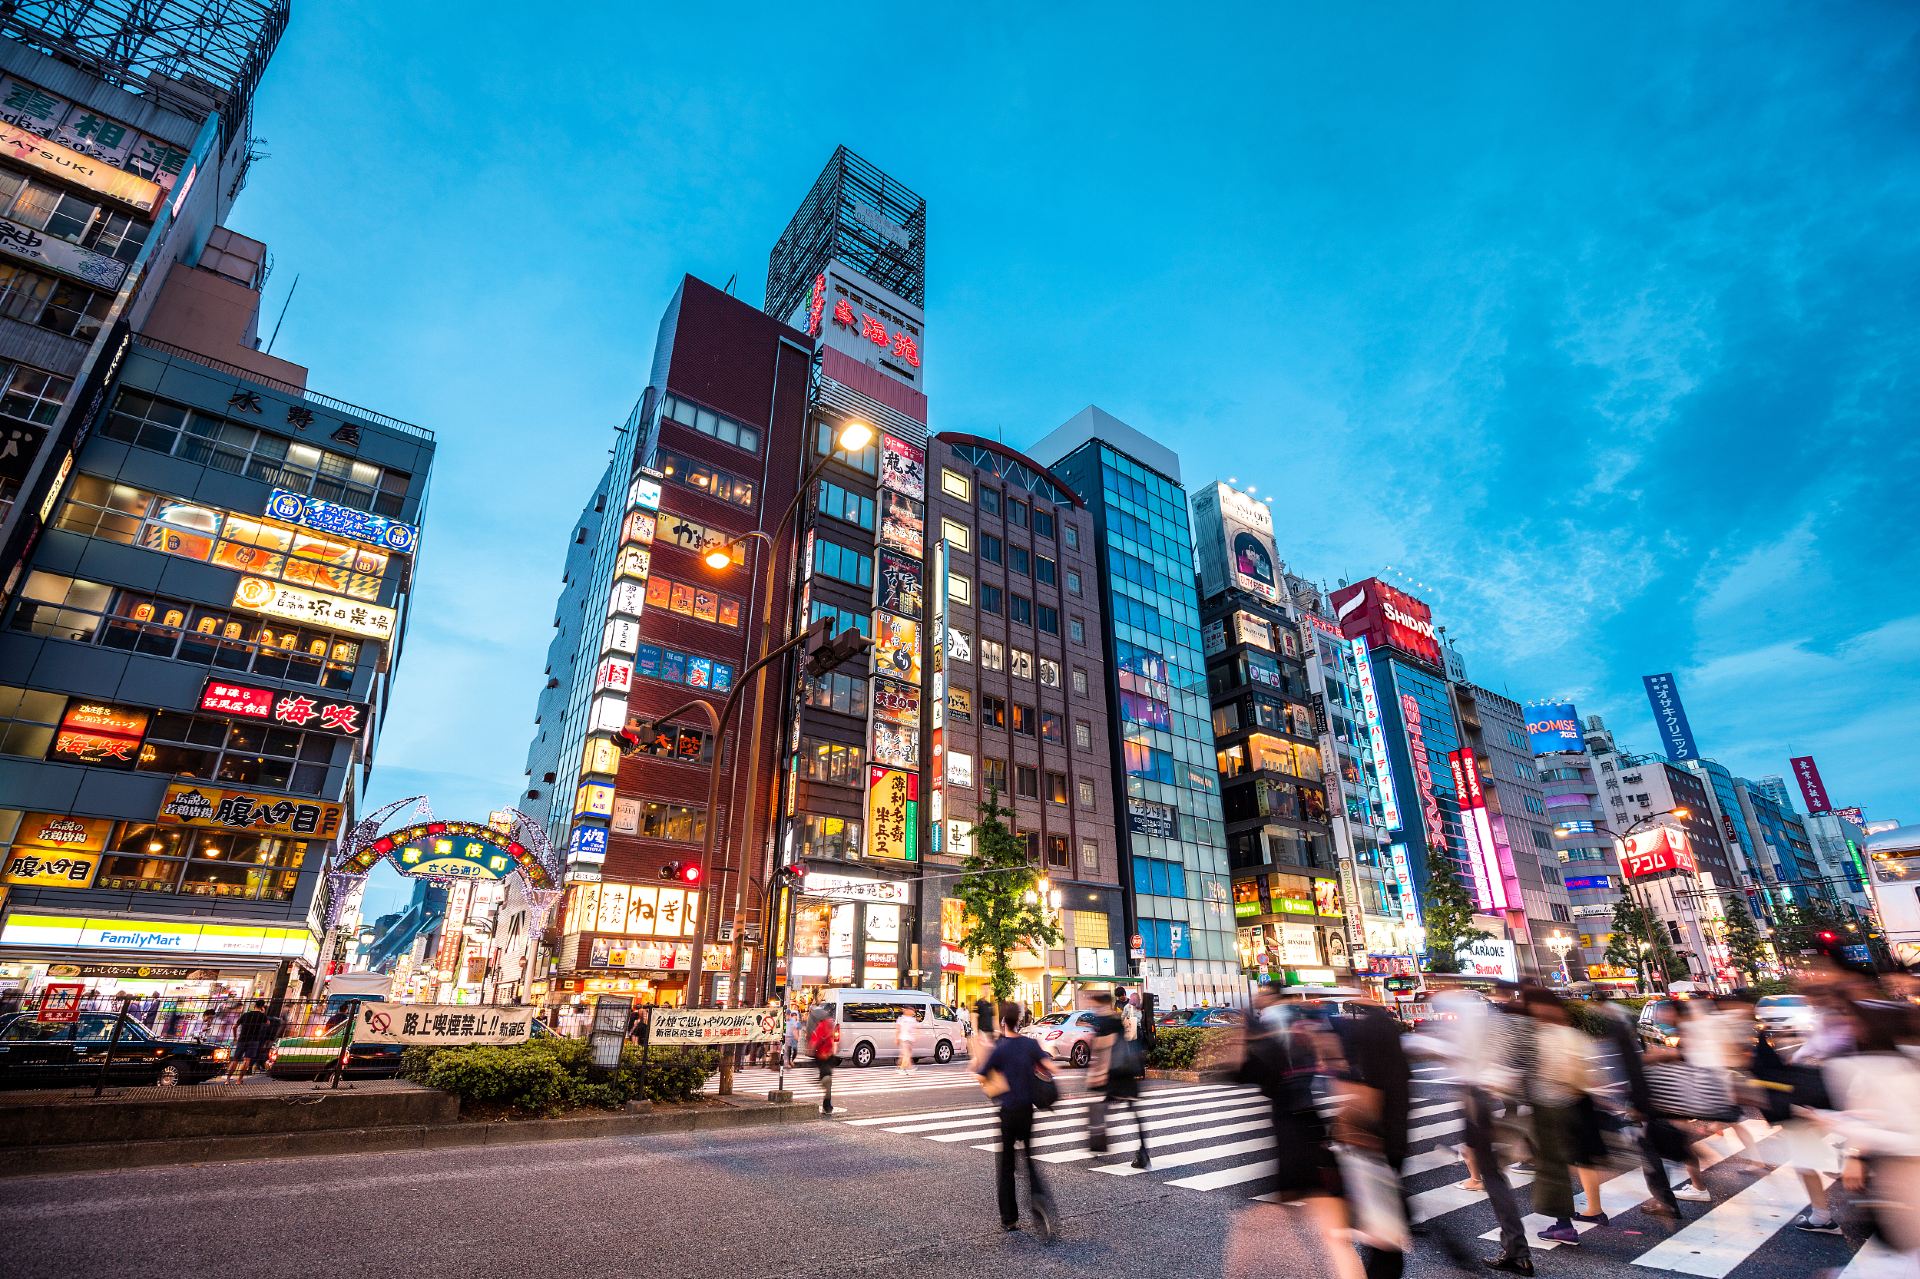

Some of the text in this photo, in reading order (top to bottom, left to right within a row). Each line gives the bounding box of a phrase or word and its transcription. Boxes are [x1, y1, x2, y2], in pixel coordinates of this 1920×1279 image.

[1383, 602, 1437, 641] SHIDAX
[276, 695, 360, 734] 海峡
[1656, 689, 1688, 758] オザキクリニック
[1464, 757, 1481, 798] SHIDAX
[176, 792, 211, 806] 伝説の
[211, 795, 321, 834] 腹八分目
[5, 855, 92, 881] 腹八分目
[1630, 854, 1667, 872] アコム
[1675, 851, 1693, 868] アコム
[429, 864, 481, 876] さくら通り
[100, 932, 181, 947] FamilyMart
[1470, 944, 1505, 957] KARAOKE
[1475, 963, 1503, 975] SHIDAX
[402, 1012, 526, 1036] 路上喫煙禁止!! 新宿区
[655, 1015, 755, 1028] 分煙で思いやりの街に。
[656, 1028, 703, 1038] 新宿区内全域
